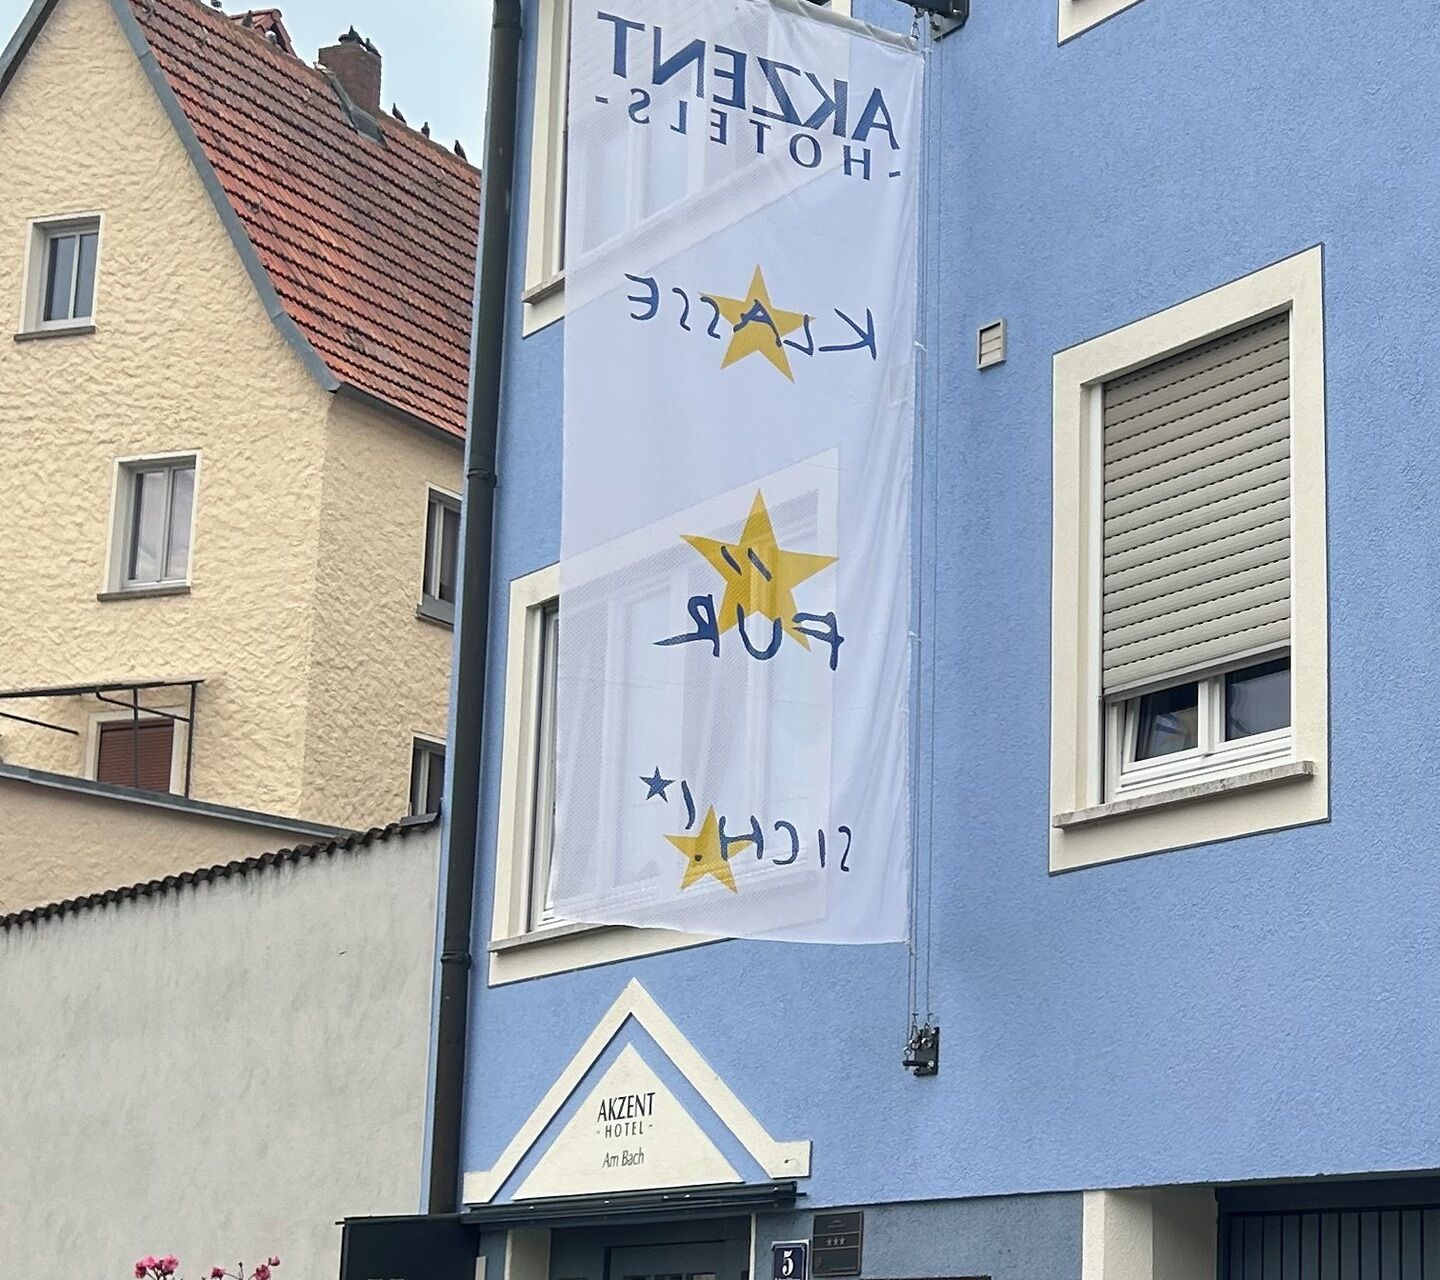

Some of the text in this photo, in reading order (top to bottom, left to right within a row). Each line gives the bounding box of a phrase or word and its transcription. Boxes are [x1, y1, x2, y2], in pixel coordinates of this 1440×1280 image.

[597, 1092, 656, 1123] AKZENT
[602, 1147, 645, 1168] Am Bach
[782, 1249, 794, 1276] 5
